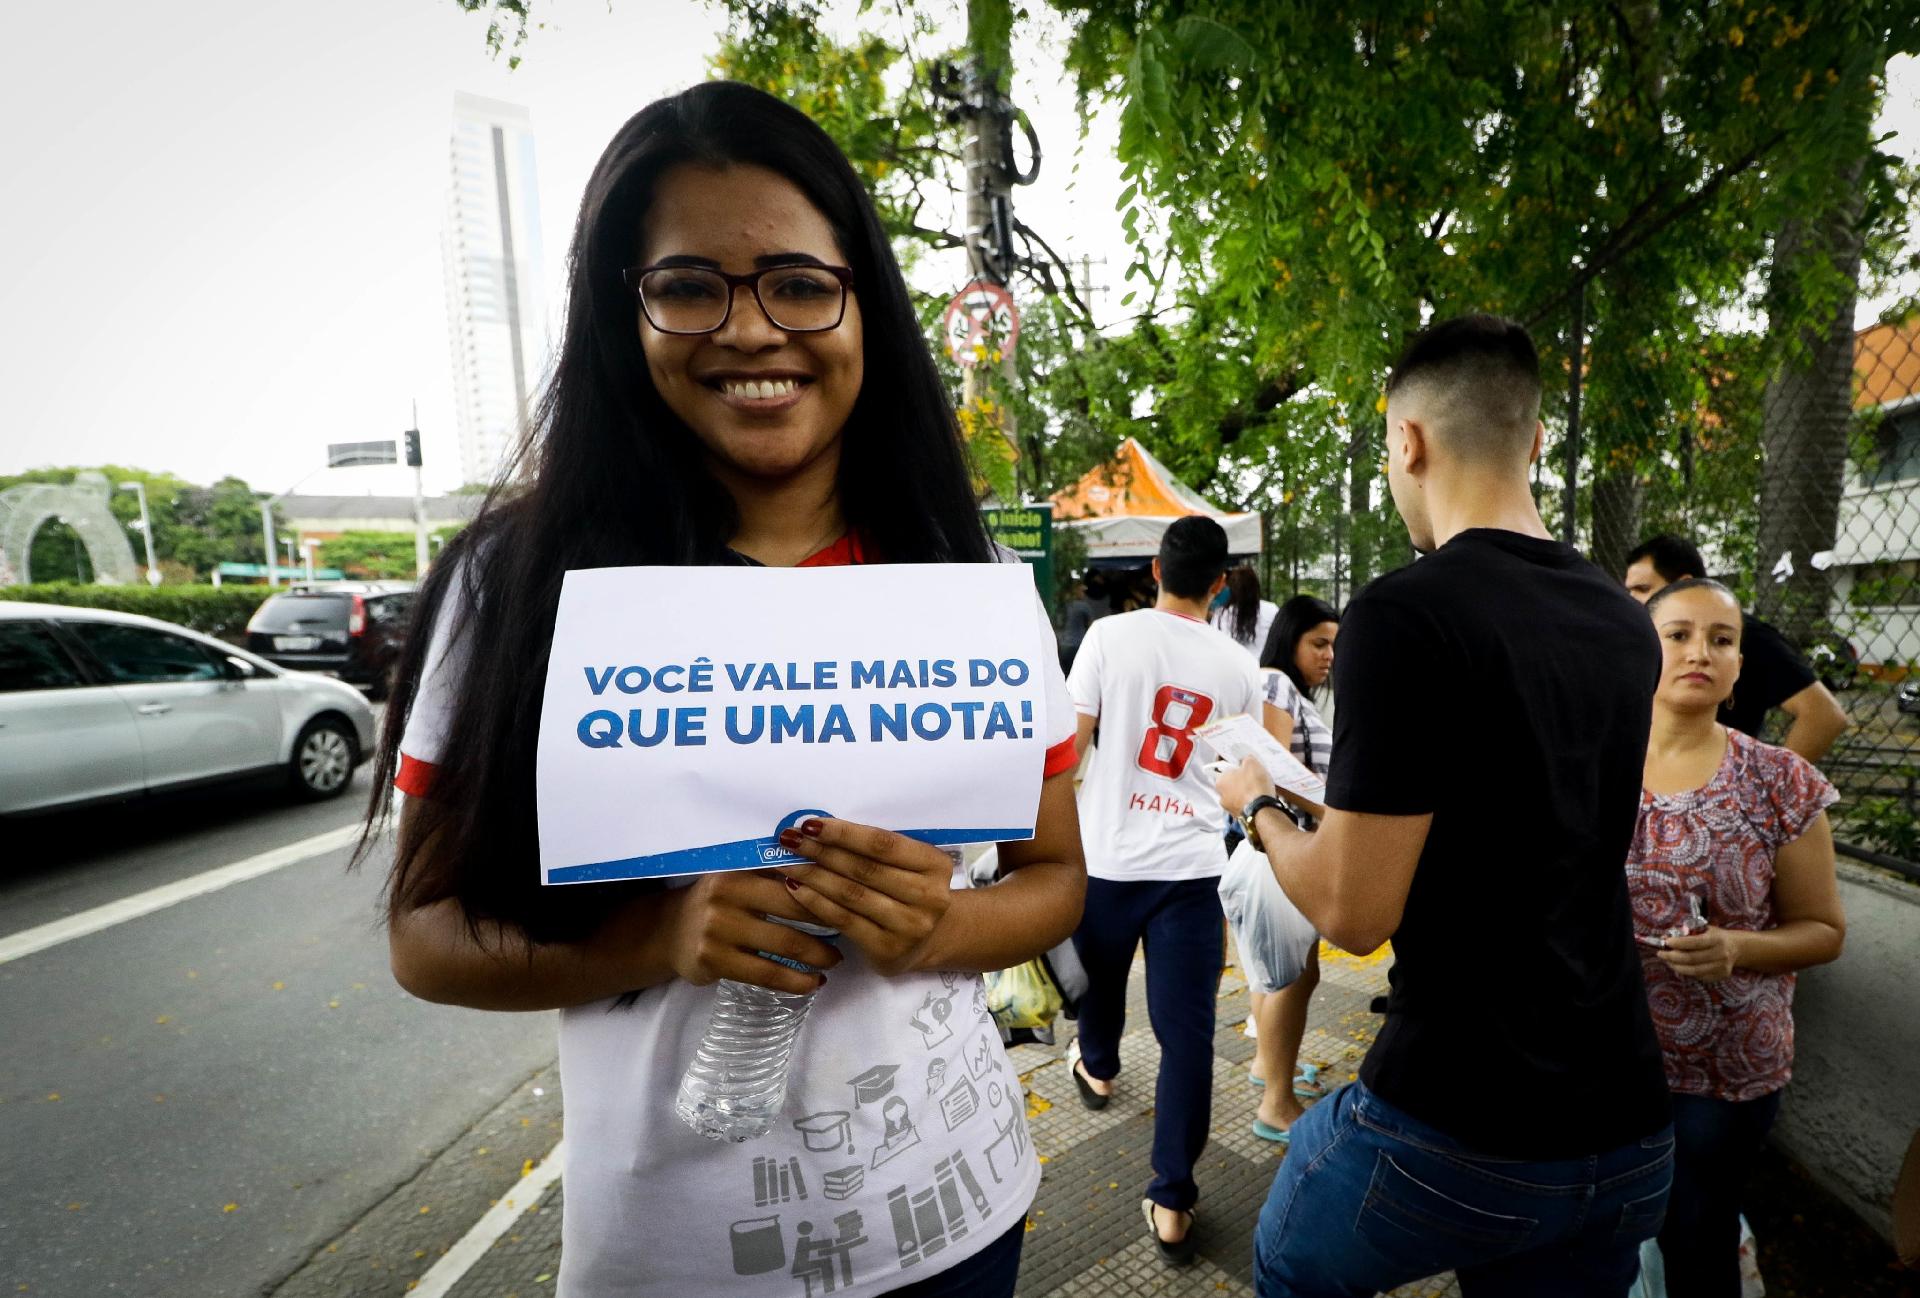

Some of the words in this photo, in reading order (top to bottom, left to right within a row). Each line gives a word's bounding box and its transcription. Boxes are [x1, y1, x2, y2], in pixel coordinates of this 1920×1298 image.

[584, 657, 714, 695] VOCÊ
[725, 661, 838, 691] VALE
[851, 659, 957, 689] MAIS
[969, 658, 1030, 687] DO
[576, 704, 708, 749] QUE
[725, 703, 857, 745] UMA
[870, 700, 1034, 742] NOTA!
[1137, 685, 1215, 779] 8
[1129, 792, 1195, 817] KAKA
